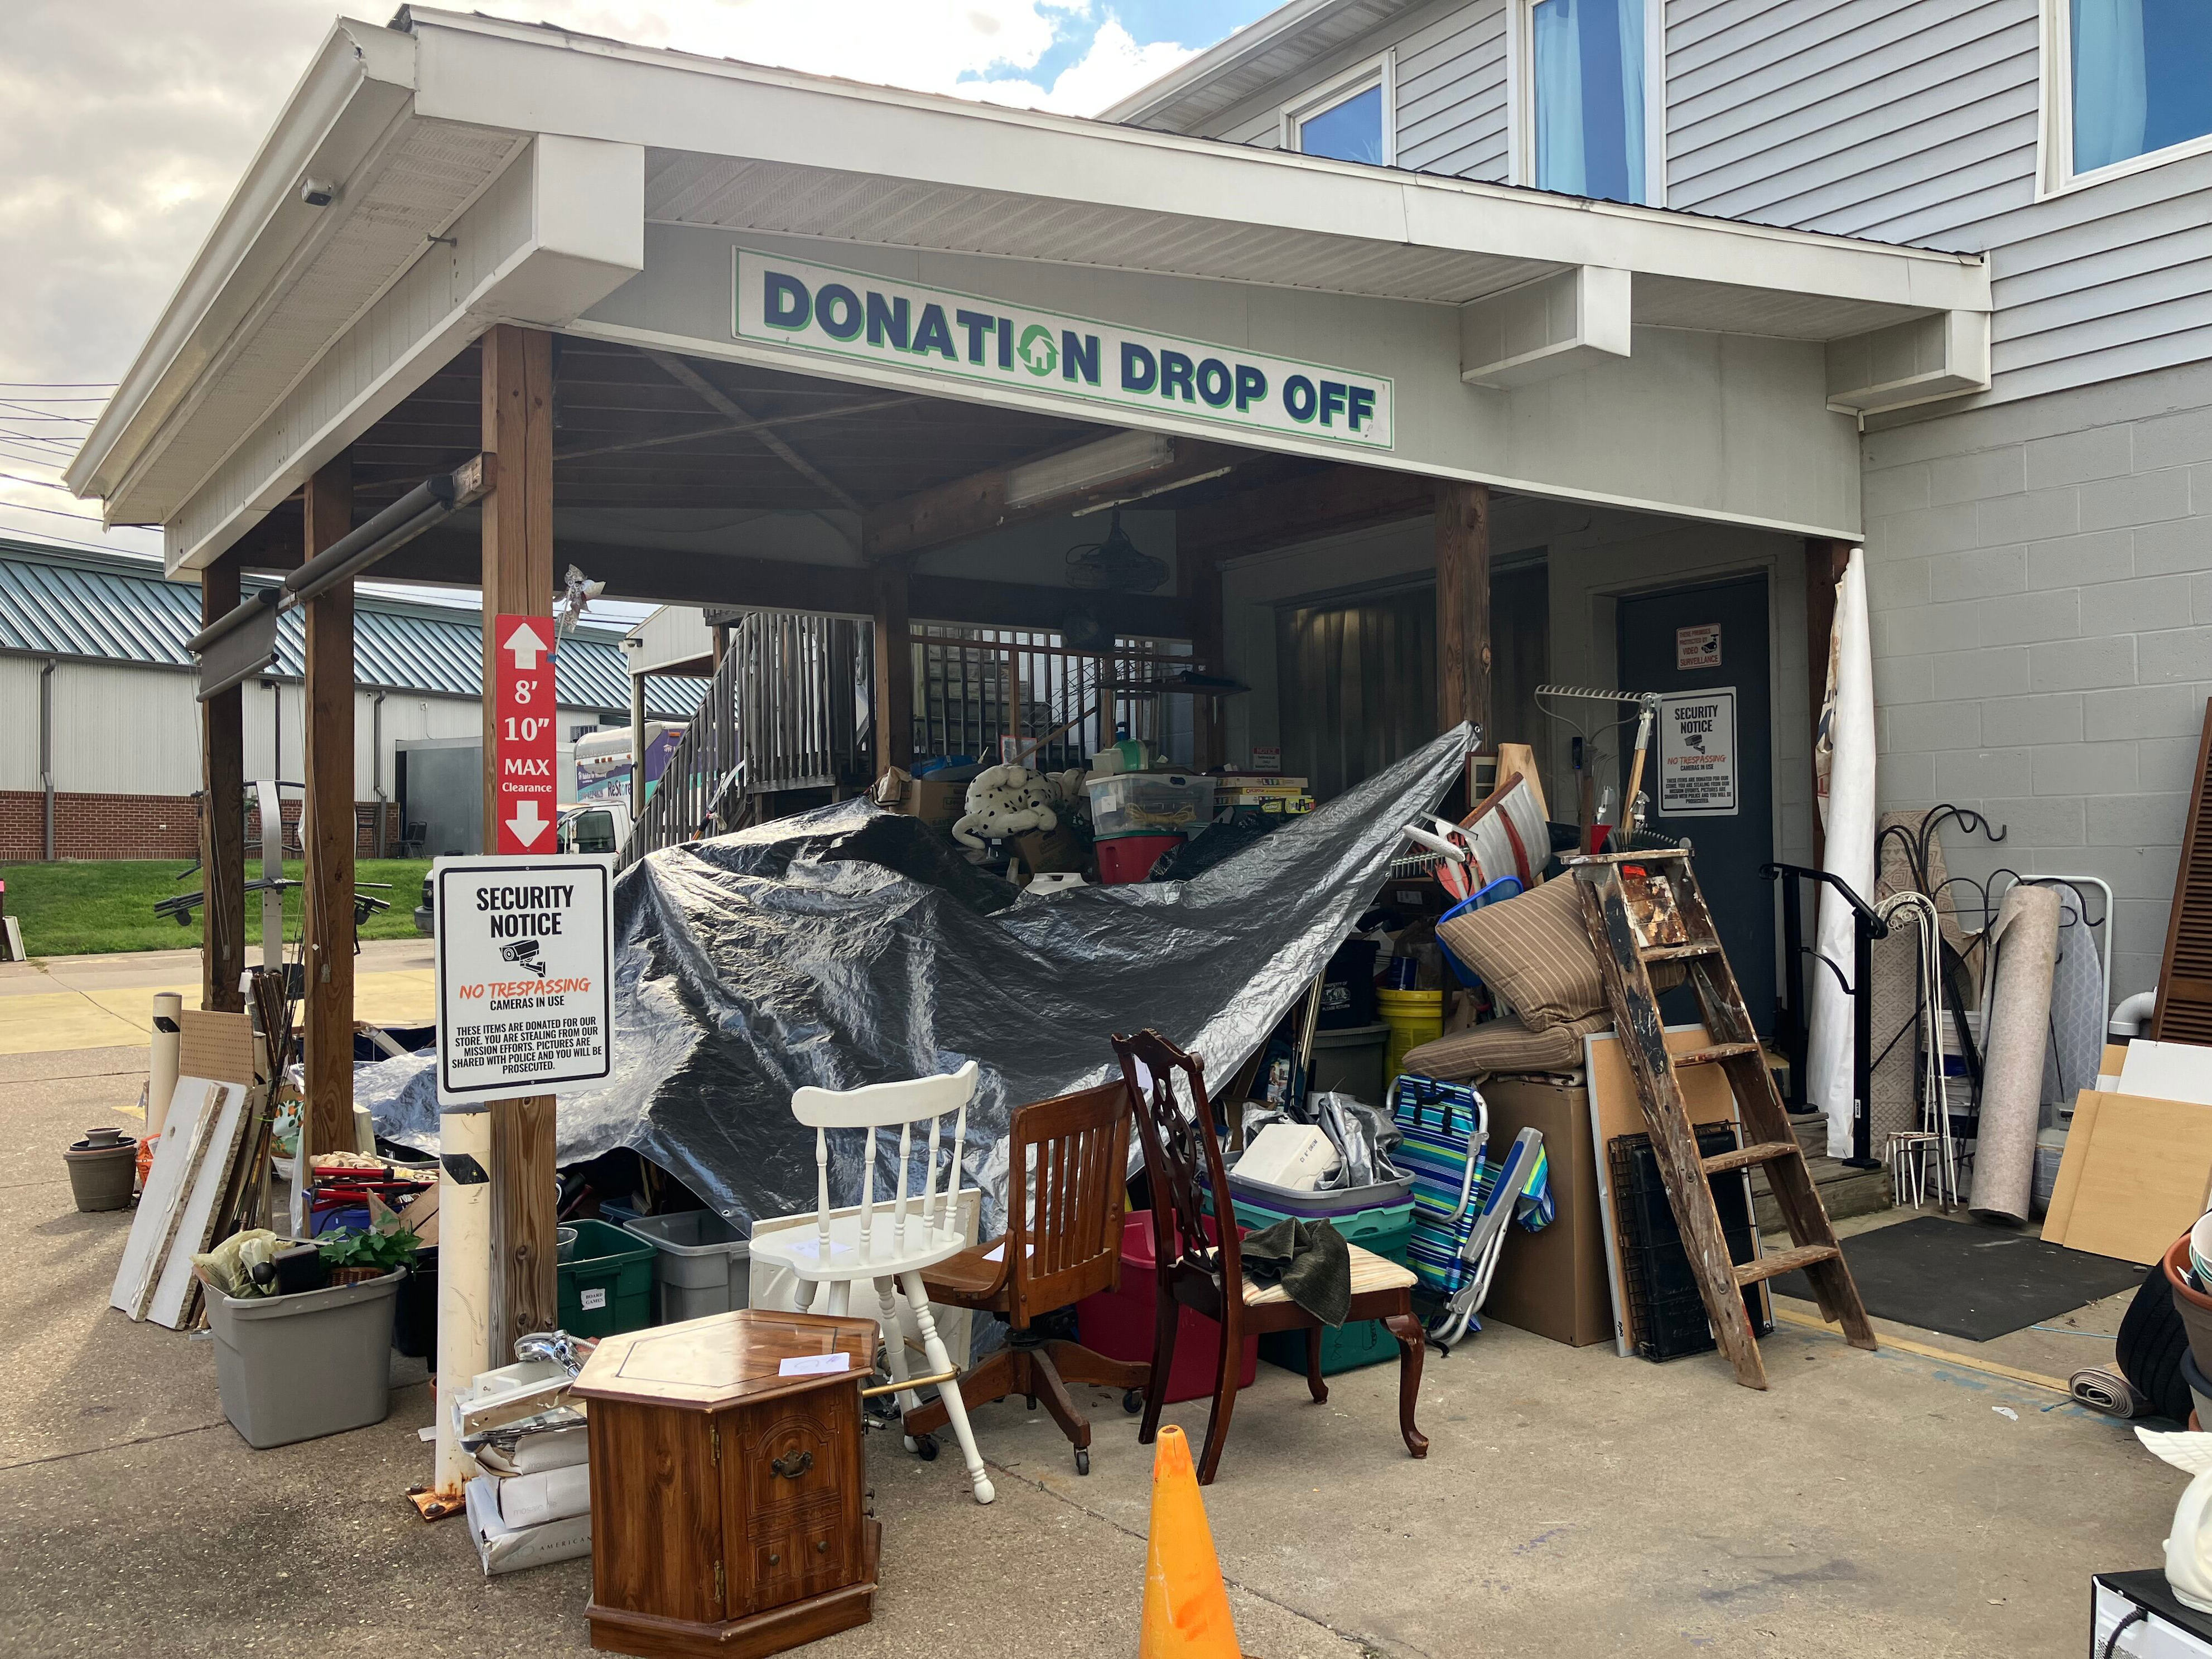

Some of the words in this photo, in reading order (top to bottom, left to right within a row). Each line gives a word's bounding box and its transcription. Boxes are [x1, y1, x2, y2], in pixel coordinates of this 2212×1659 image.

[763, 271, 1101, 386] DONATION
[1120, 342, 1268, 412] DROP
[1283, 374, 1376, 430] OFF
[1683, 647, 1698, 655] VIDEO
[1680, 655, 1718, 666] SURVEILLANCE
[1674, 705, 1718, 721] SECURITY
[1680, 720, 1713, 734] NOTICE
[504, 759, 550, 775] MAX
[1679, 755, 1727, 765] TRESPASSING
[502, 782, 552, 792] Clearance
[608, 780, 632, 797] ReStore
[476, 885, 574, 911] SECURITY
[490, 913, 562, 938] NOTICE
[459, 984, 484, 999] NO
[488, 977, 591, 999] TRESPASSING
[490, 997, 533, 1010] CAMERAS
[536, 997, 545, 1007] IN
[548, 996, 565, 1006] USE
[456, 1025, 481, 1036] THESE
[483, 1024, 506, 1034] ITEMS
[508, 1022, 523, 1032] ARE
[526, 1019, 561, 1030] DONATED
[563, 1018, 577, 1028] FOR
[580, 1016, 596, 1026] OUR
[455, 1036, 483, 1046] STORE.
[485, 1034, 500, 1044] YOU
[503, 1033, 518, 1043] ARE
[521, 1030, 556, 1041] STEALING
[558, 1028, 580, 1038] FROM
[582, 1026, 598, 1036] OUR
[464, 1045, 498, 1057] MISSION
[500, 1042, 534, 1054] EFFORTS.
[537, 1038, 574, 1050] PICTURES
[576, 1037, 591, 1047] ARE
[452, 1057, 484, 1068] SHARED
[487, 1055, 506, 1065] WITH
[509, 1052, 536, 1063] POLICE
[538, 1050, 554, 1060] AND
[556, 1049, 571, 1059] YOU
[574, 1047, 591, 1057] WILL
[592, 1046, 602, 1055] BE
[503, 1061, 555, 1074] PROSECUTED.
[1308, 1139, 1318, 1151] DRUM
[513, 1504, 542, 1516] mosaic
[540, 1536, 591, 1551] AMERICAN
